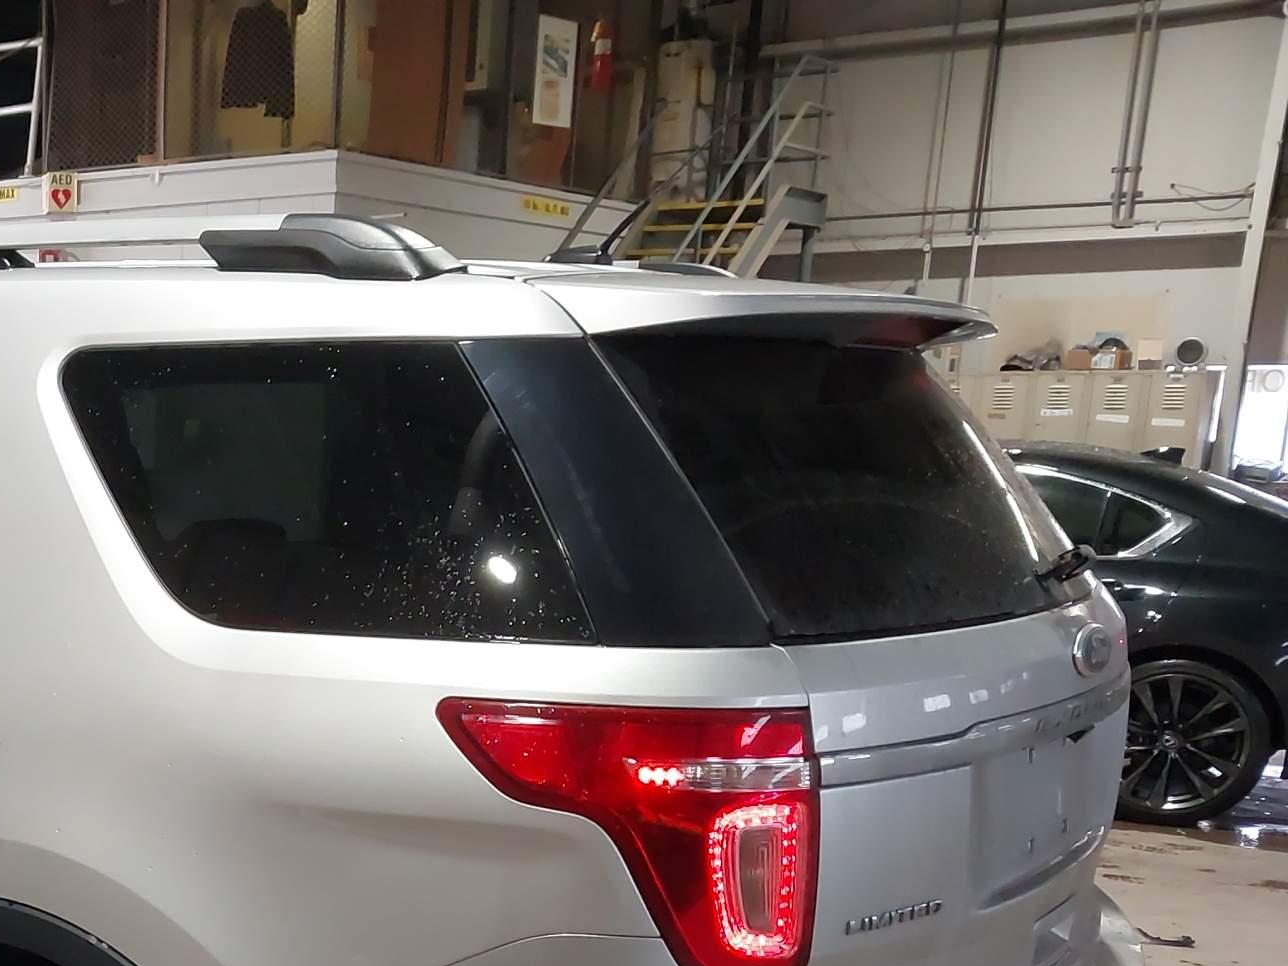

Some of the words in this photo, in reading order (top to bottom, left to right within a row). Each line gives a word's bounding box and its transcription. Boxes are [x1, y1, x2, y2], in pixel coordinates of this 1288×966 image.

[50, 173, 72, 185] AED
[0, 188, 15, 200] MAX
[844, 900, 942, 935] LIMITED
